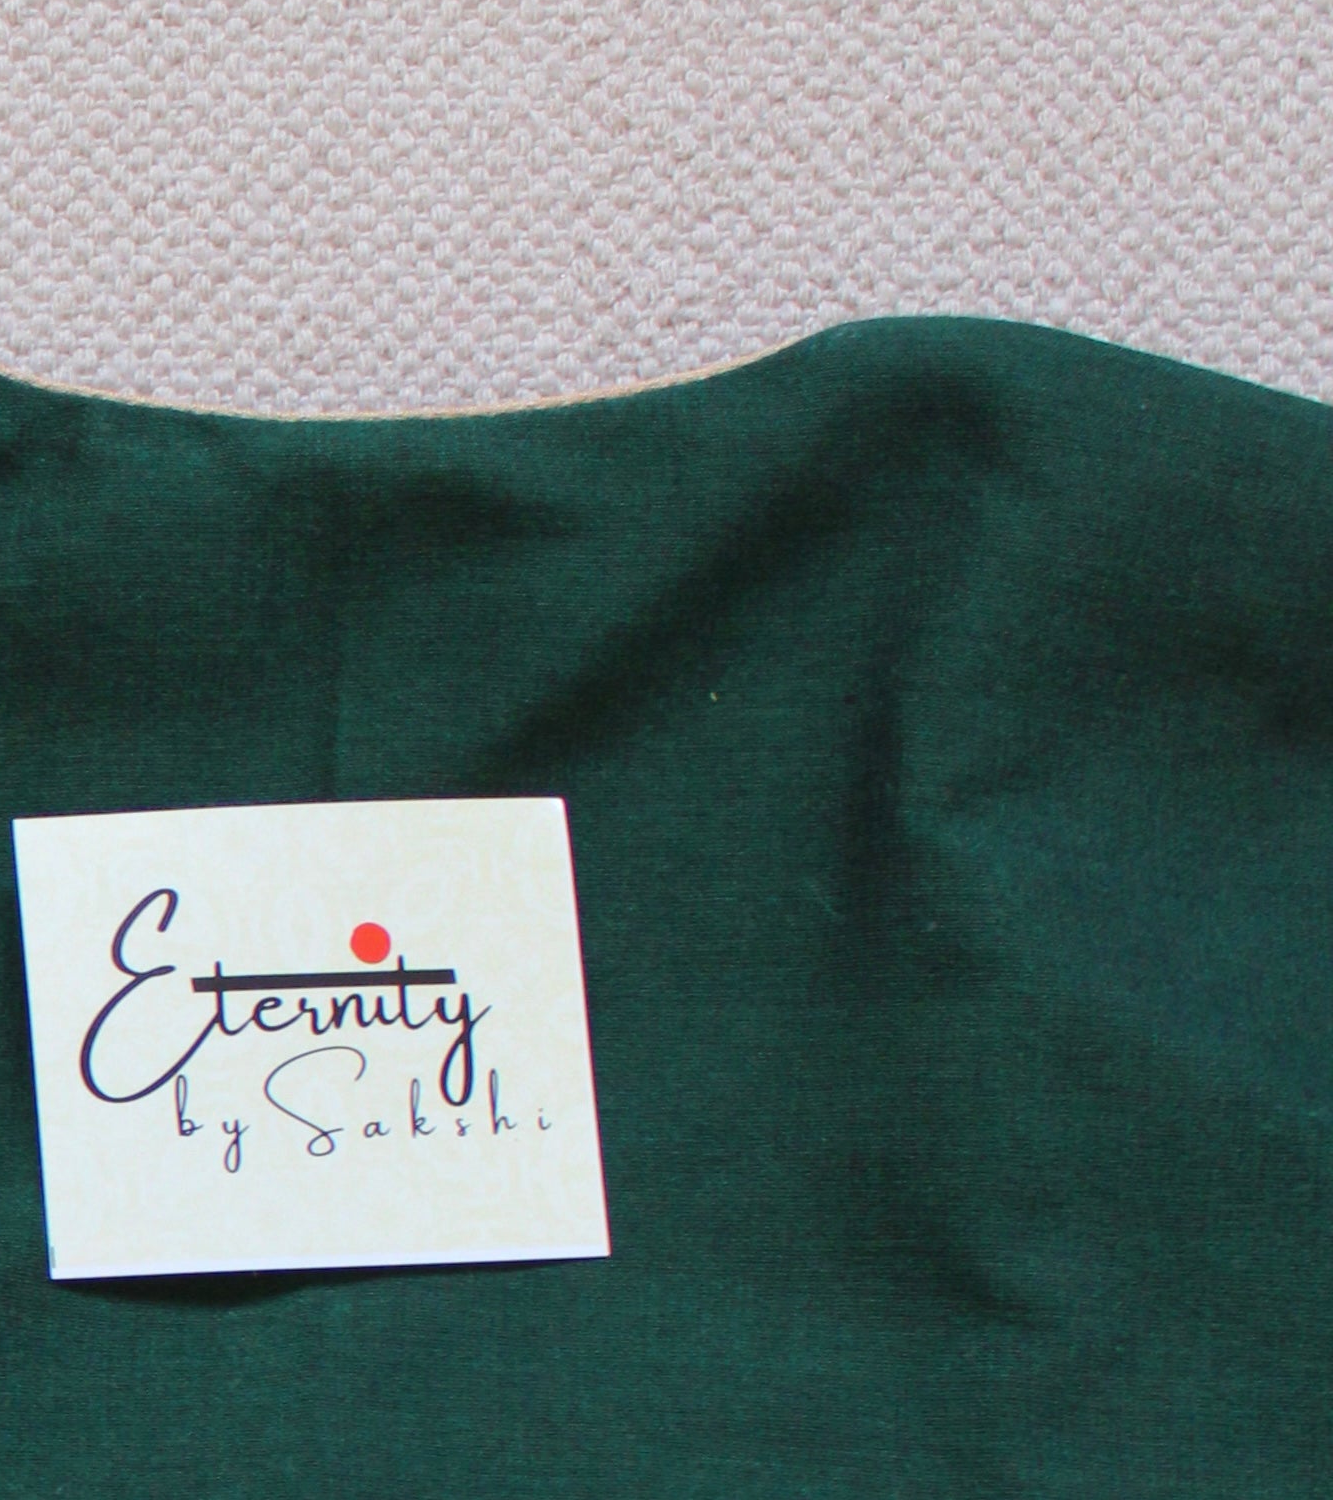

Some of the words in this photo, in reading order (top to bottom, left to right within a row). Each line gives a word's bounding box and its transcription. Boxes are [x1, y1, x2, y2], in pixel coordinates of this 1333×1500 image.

[79, 887, 493, 1107] Eternity
[174, 1074, 250, 1174] by
[263, 1045, 553, 1157] Sakshi
